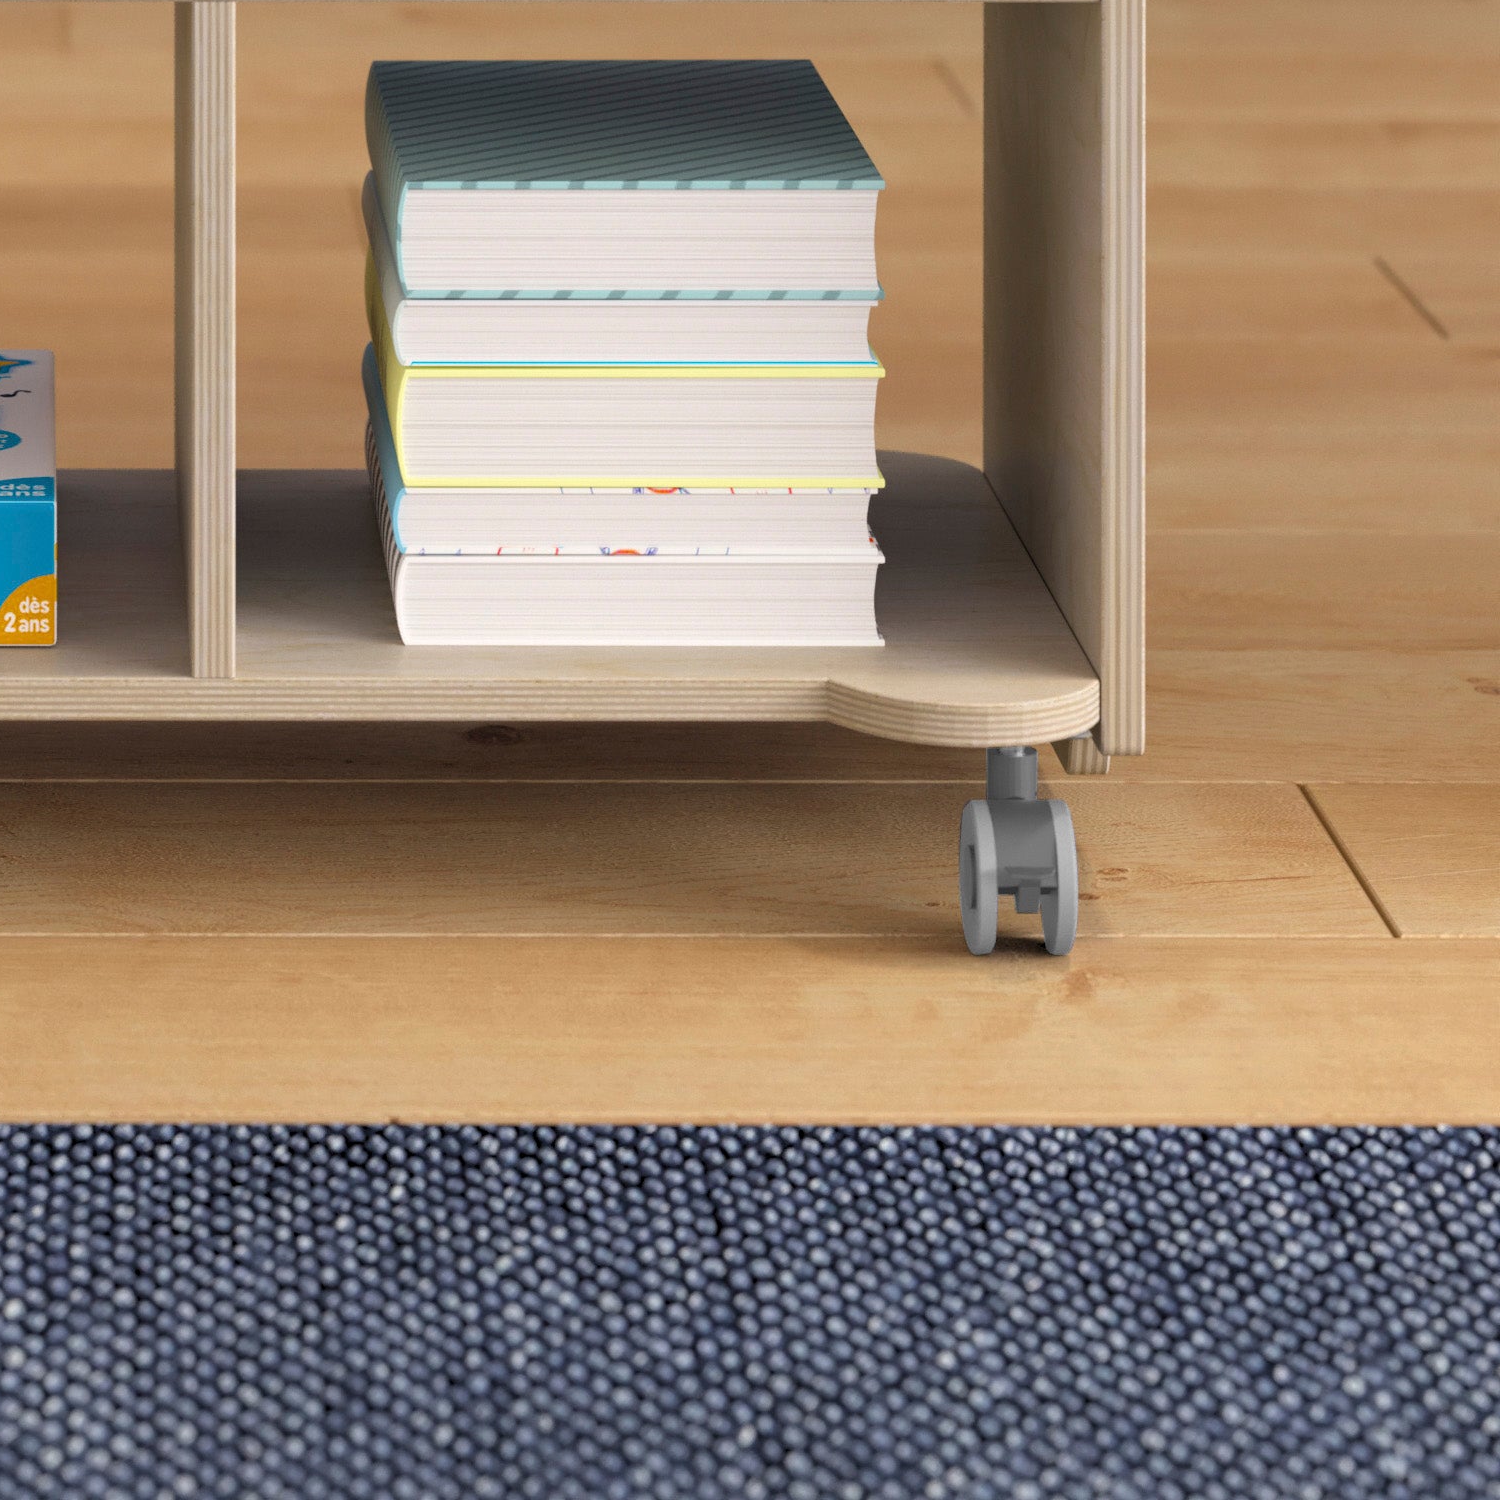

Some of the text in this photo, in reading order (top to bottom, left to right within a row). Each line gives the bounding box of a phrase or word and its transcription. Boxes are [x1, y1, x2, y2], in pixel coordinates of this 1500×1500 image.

[19, 595, 50, 614] dès
[3, 611, 50, 633] 2 ans
